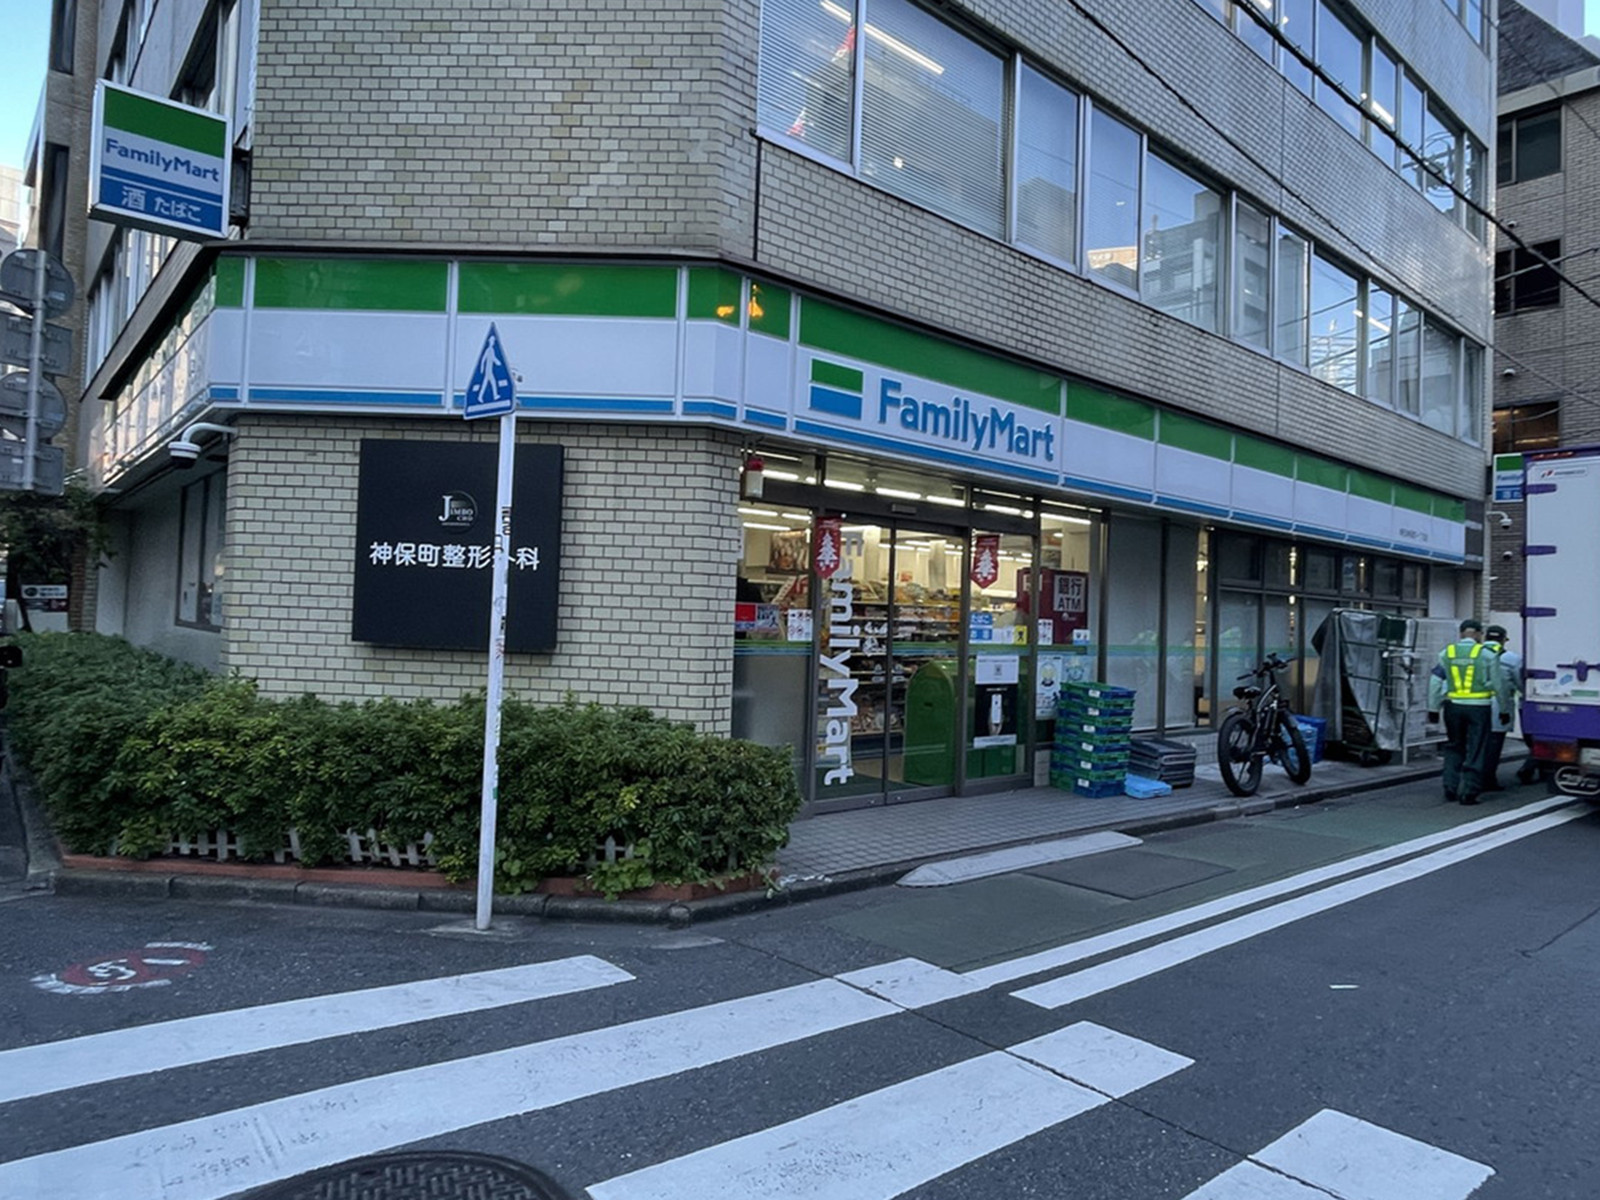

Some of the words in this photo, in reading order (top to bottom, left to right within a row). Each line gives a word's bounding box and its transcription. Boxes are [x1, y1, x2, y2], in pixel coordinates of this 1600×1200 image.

[105, 138, 219, 182] FamilyMart
[121, 186, 146, 212] 酒
[154, 196, 202, 222] たばこ
[878, 377, 1054, 462] FamilyMart
[1057, 597, 1081, 611] ATM
[1058, 577, 1082, 597] 銀行
